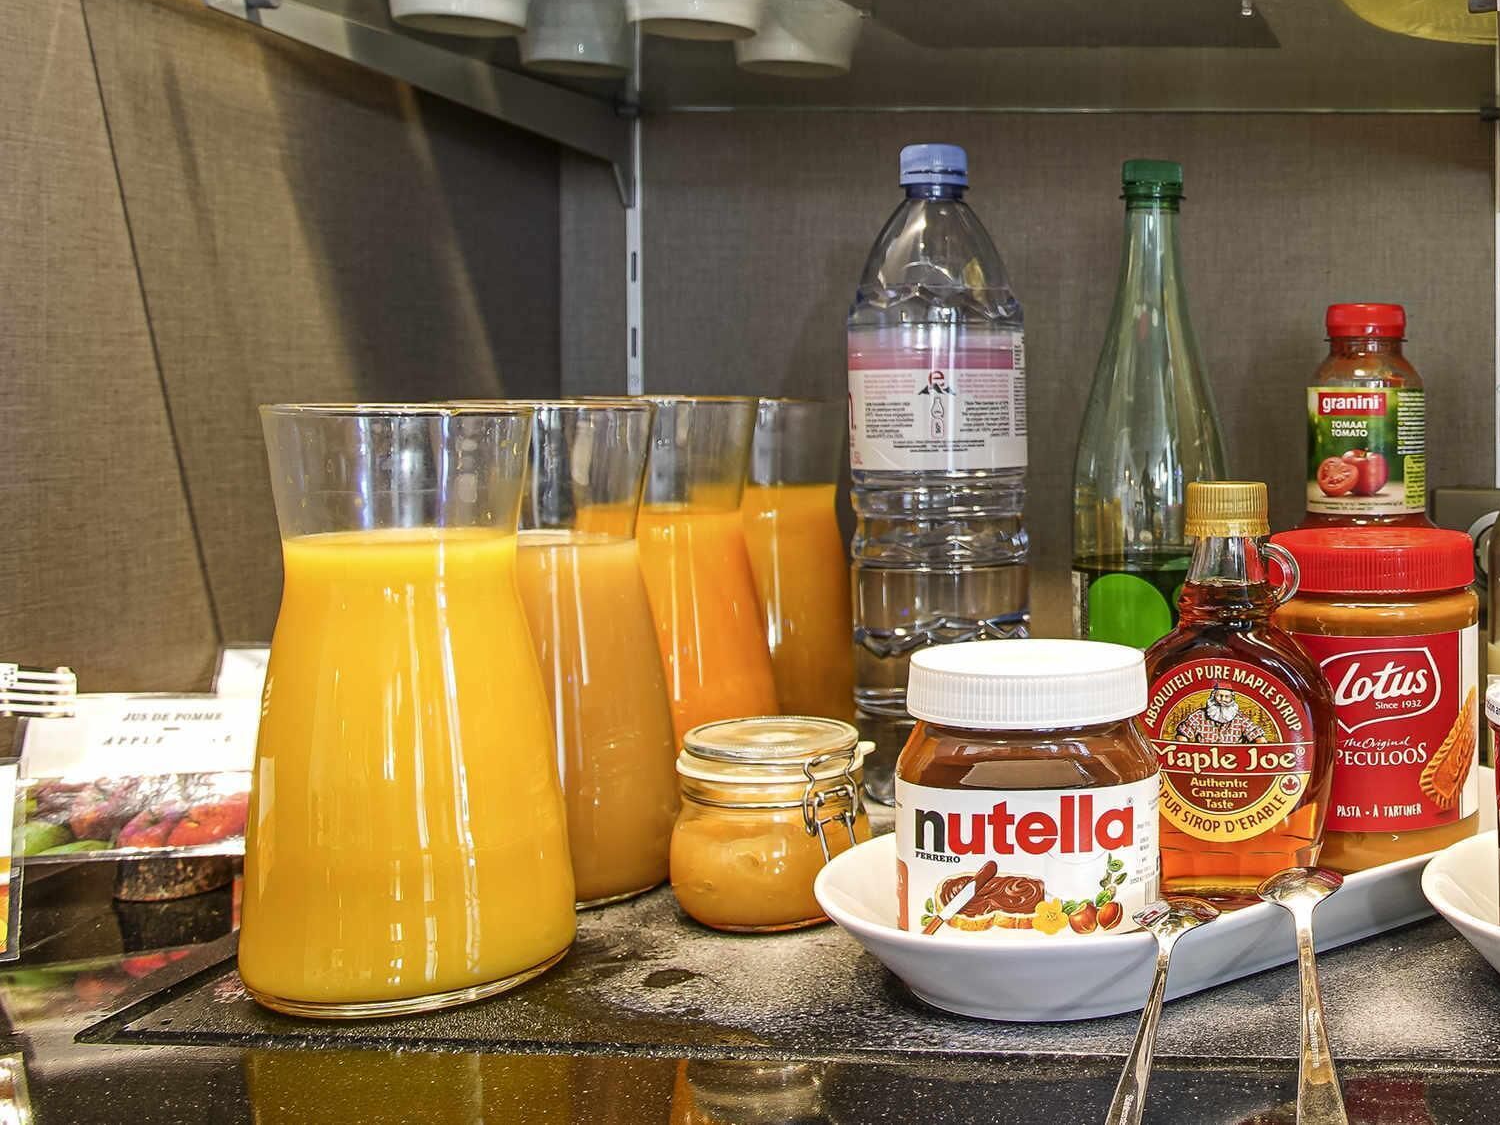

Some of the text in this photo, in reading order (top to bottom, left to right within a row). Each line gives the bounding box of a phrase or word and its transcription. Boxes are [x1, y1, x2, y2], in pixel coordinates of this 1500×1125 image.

[1322, 395, 1379, 413] granini
[1332, 420, 1368, 429] TOMAAT
[1332, 429, 1368, 437] TOMATO
[1335, 661, 1428, 706] Lotus
[1144, 665, 1303, 732] ABSOLUTELY PURE MAPLE SYRUP
[1375, 699, 1422, 710] Since 1932
[122, 712, 223, 722] JUS DE POMME
[1361, 735, 1411, 752] Original
[1151, 742, 1238, 775] Maple
[1336, 742, 1428, 767] PECULOOS
[1190, 776, 1249, 789] Authentic
[1191, 787, 1249, 799] Canadian
[1160, 789, 1183, 818] PUR
[1181, 810, 1221, 833] SIROP
[1225, 794, 1287, 834] D'ERABLE
[1205, 798, 1235, 810] Taste
[1336, 805, 1362, 818] PASTA
[1384, 802, 1423, 818] TARTINER
[915, 794, 1135, 856] nutella
[915, 851, 962, 865] FERRERO
